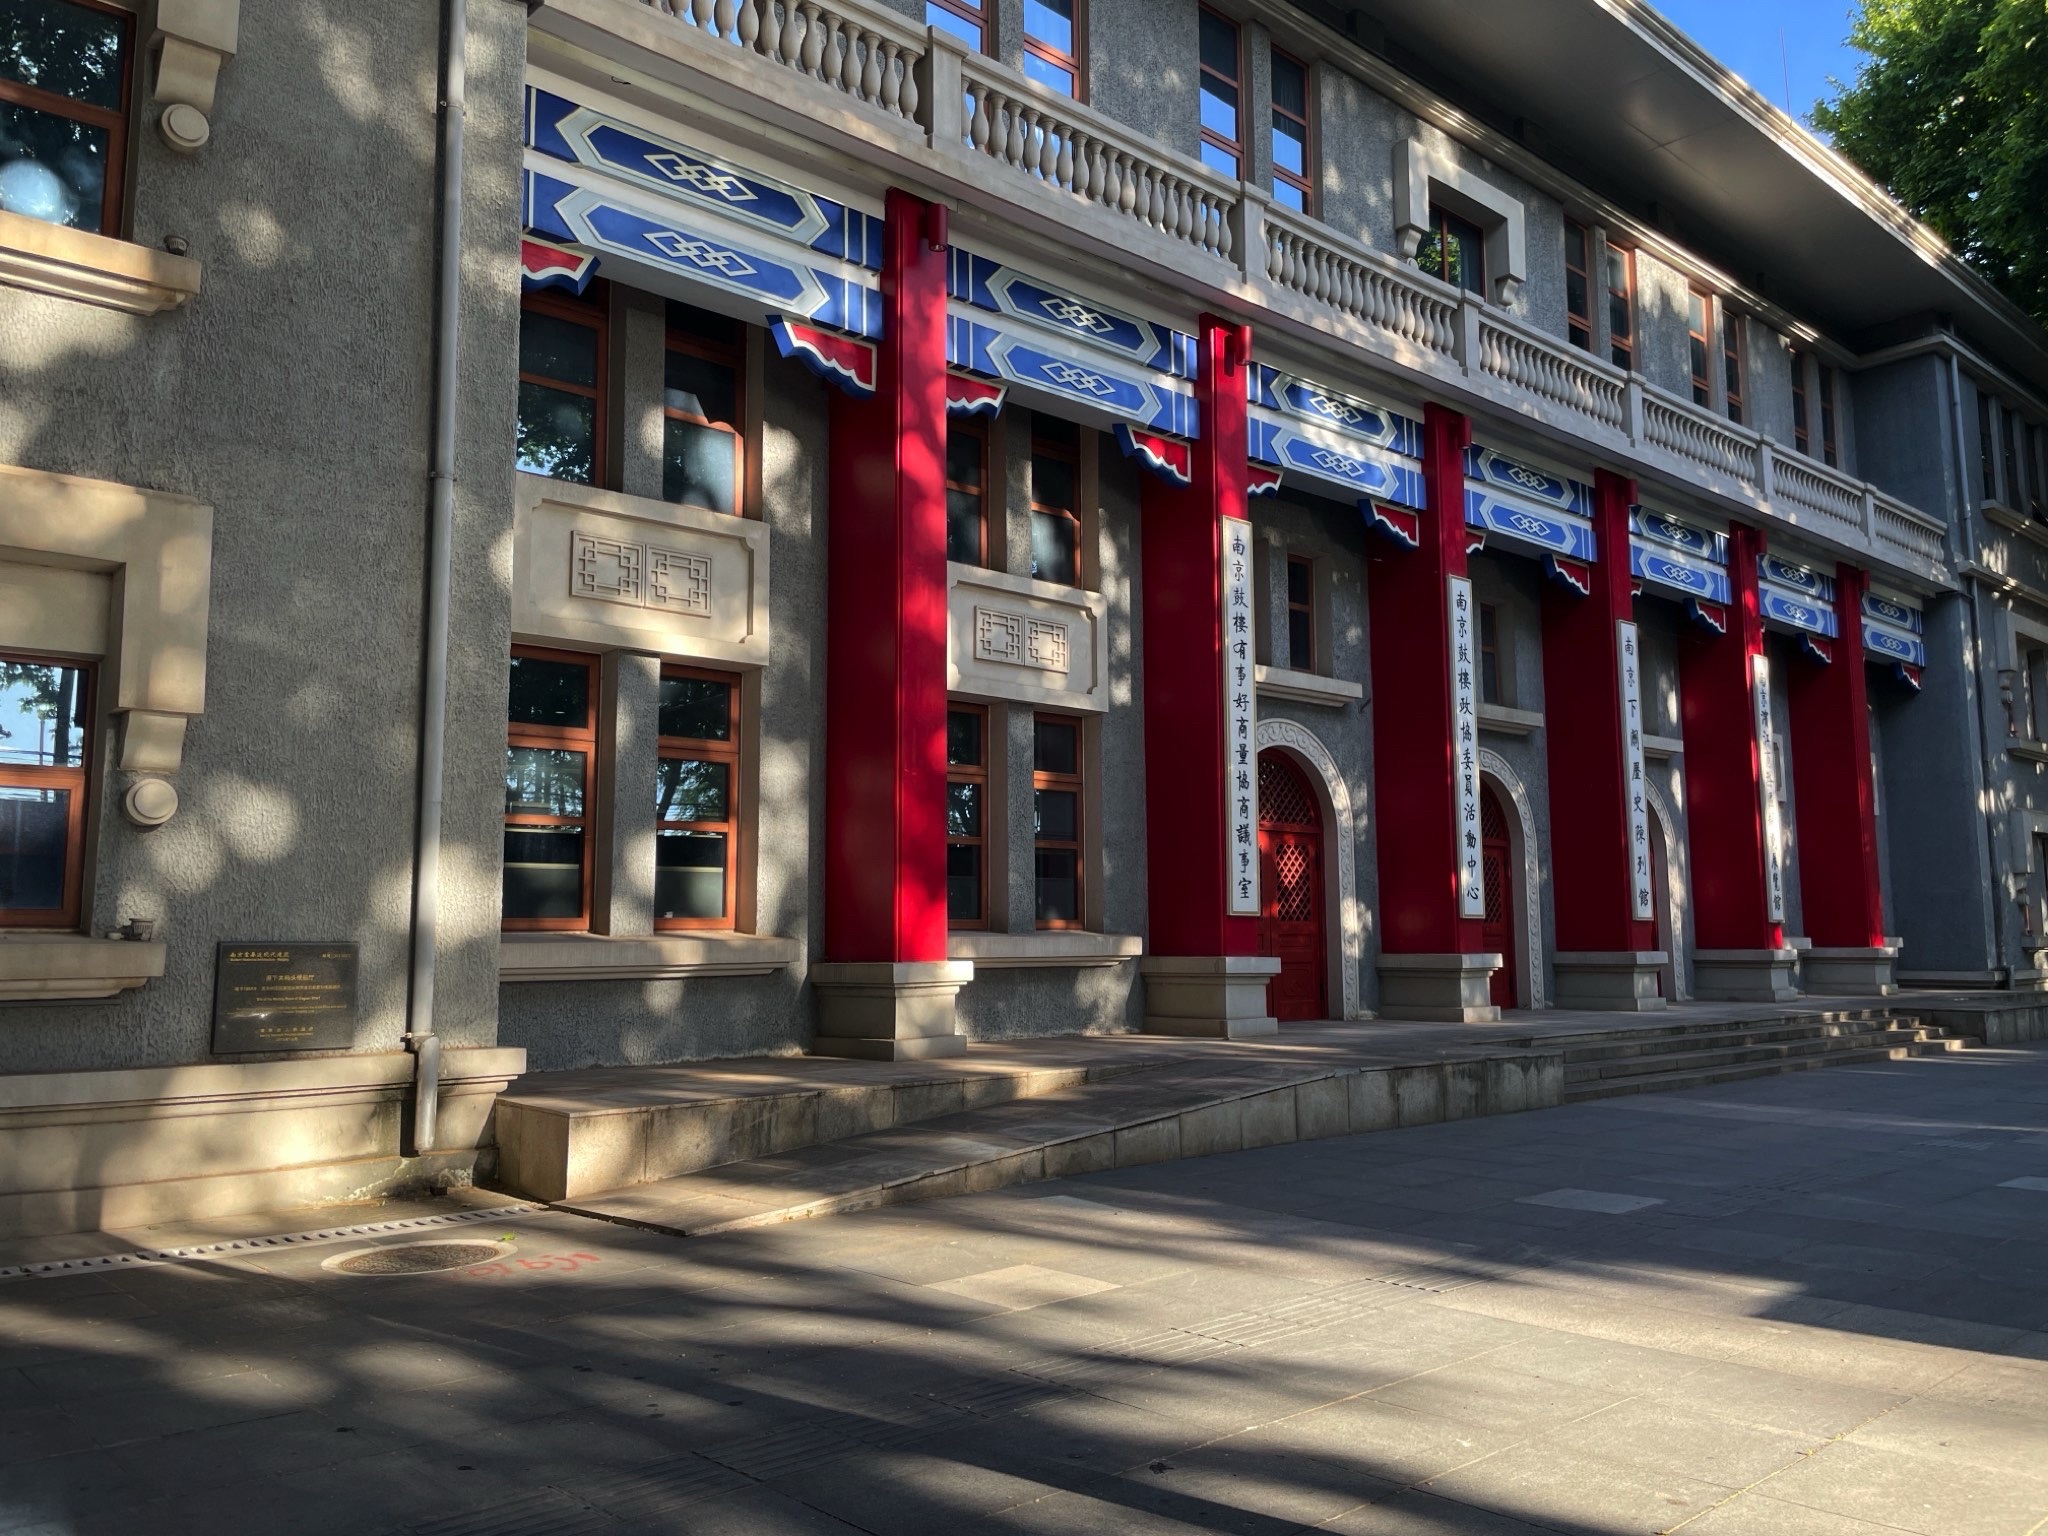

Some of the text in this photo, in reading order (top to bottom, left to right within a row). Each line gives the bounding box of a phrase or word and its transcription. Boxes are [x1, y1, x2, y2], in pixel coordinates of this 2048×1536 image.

[1456, 590, 1480, 900] 南京鼓樓政協委員活動中心
